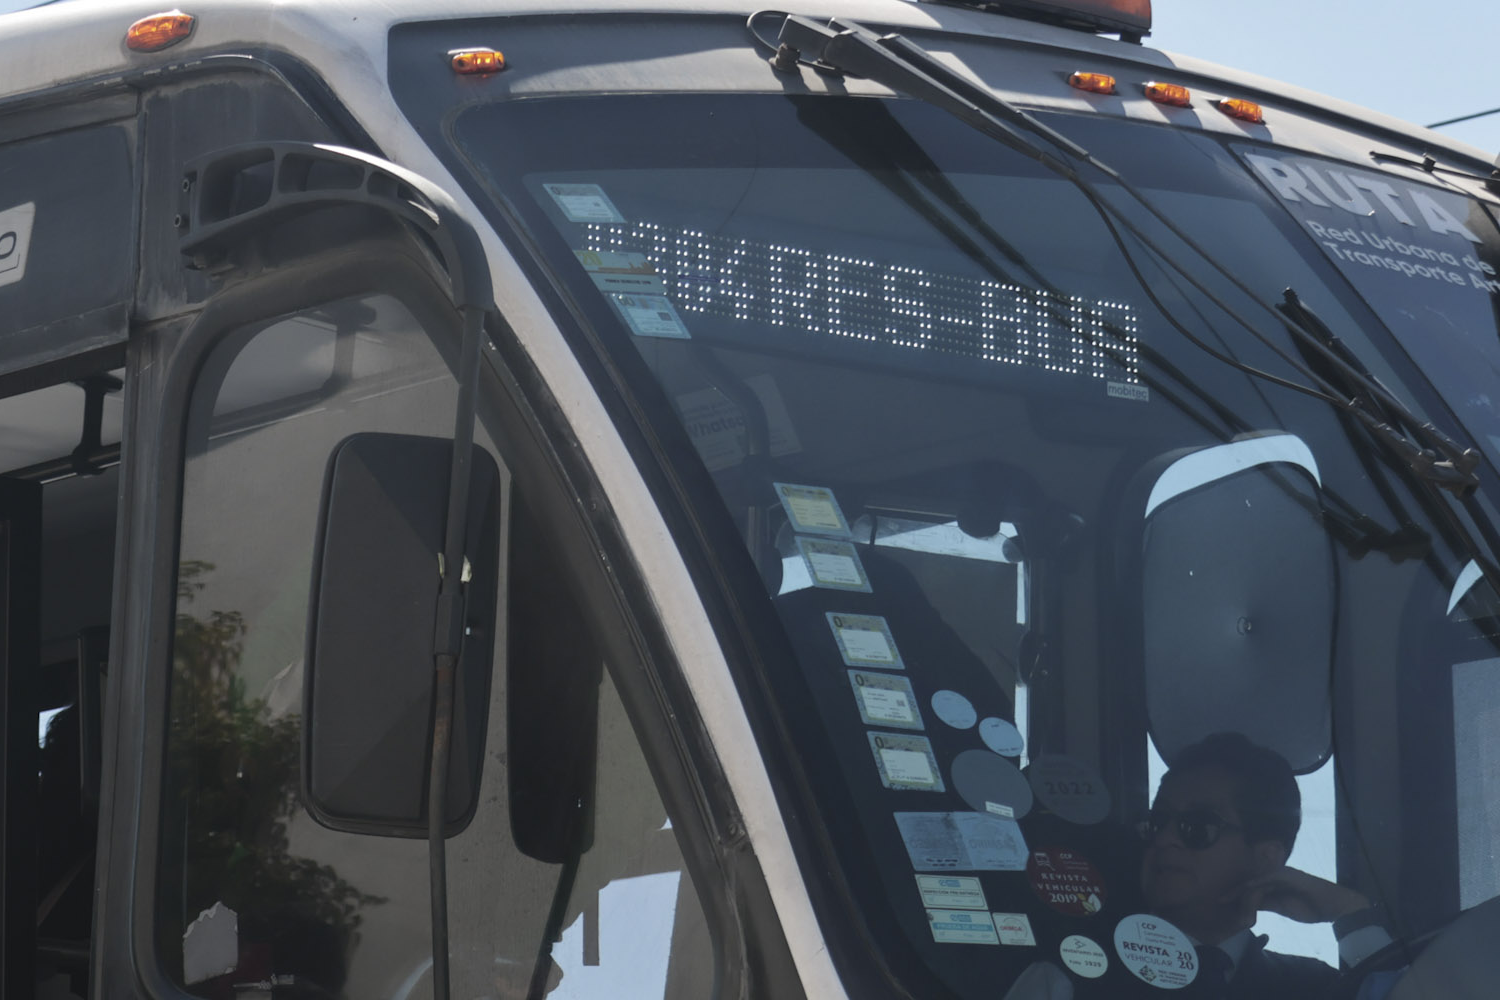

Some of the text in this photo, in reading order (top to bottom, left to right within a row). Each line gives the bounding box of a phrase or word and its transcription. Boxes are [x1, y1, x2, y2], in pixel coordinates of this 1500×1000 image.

[1244, 152, 1484, 244] RUTA
[1306, 220, 1497, 275] Red Urbana de
[1322, 241, 1467, 287] Transporte
[1108, 384, 1149, 400] mobitec
[1044, 781, 1095, 795] 2022
[1040, 872, 1088, 882] REVISTA
[1036, 882, 1101, 893] VEHICULAR
[1049, 892, 1078, 904] 2019
[1141, 922, 1157, 931] CCP
[1122, 940, 1193, 961] REVISTA 20
[1124, 952, 1195, 971] VEHICULAR 20
